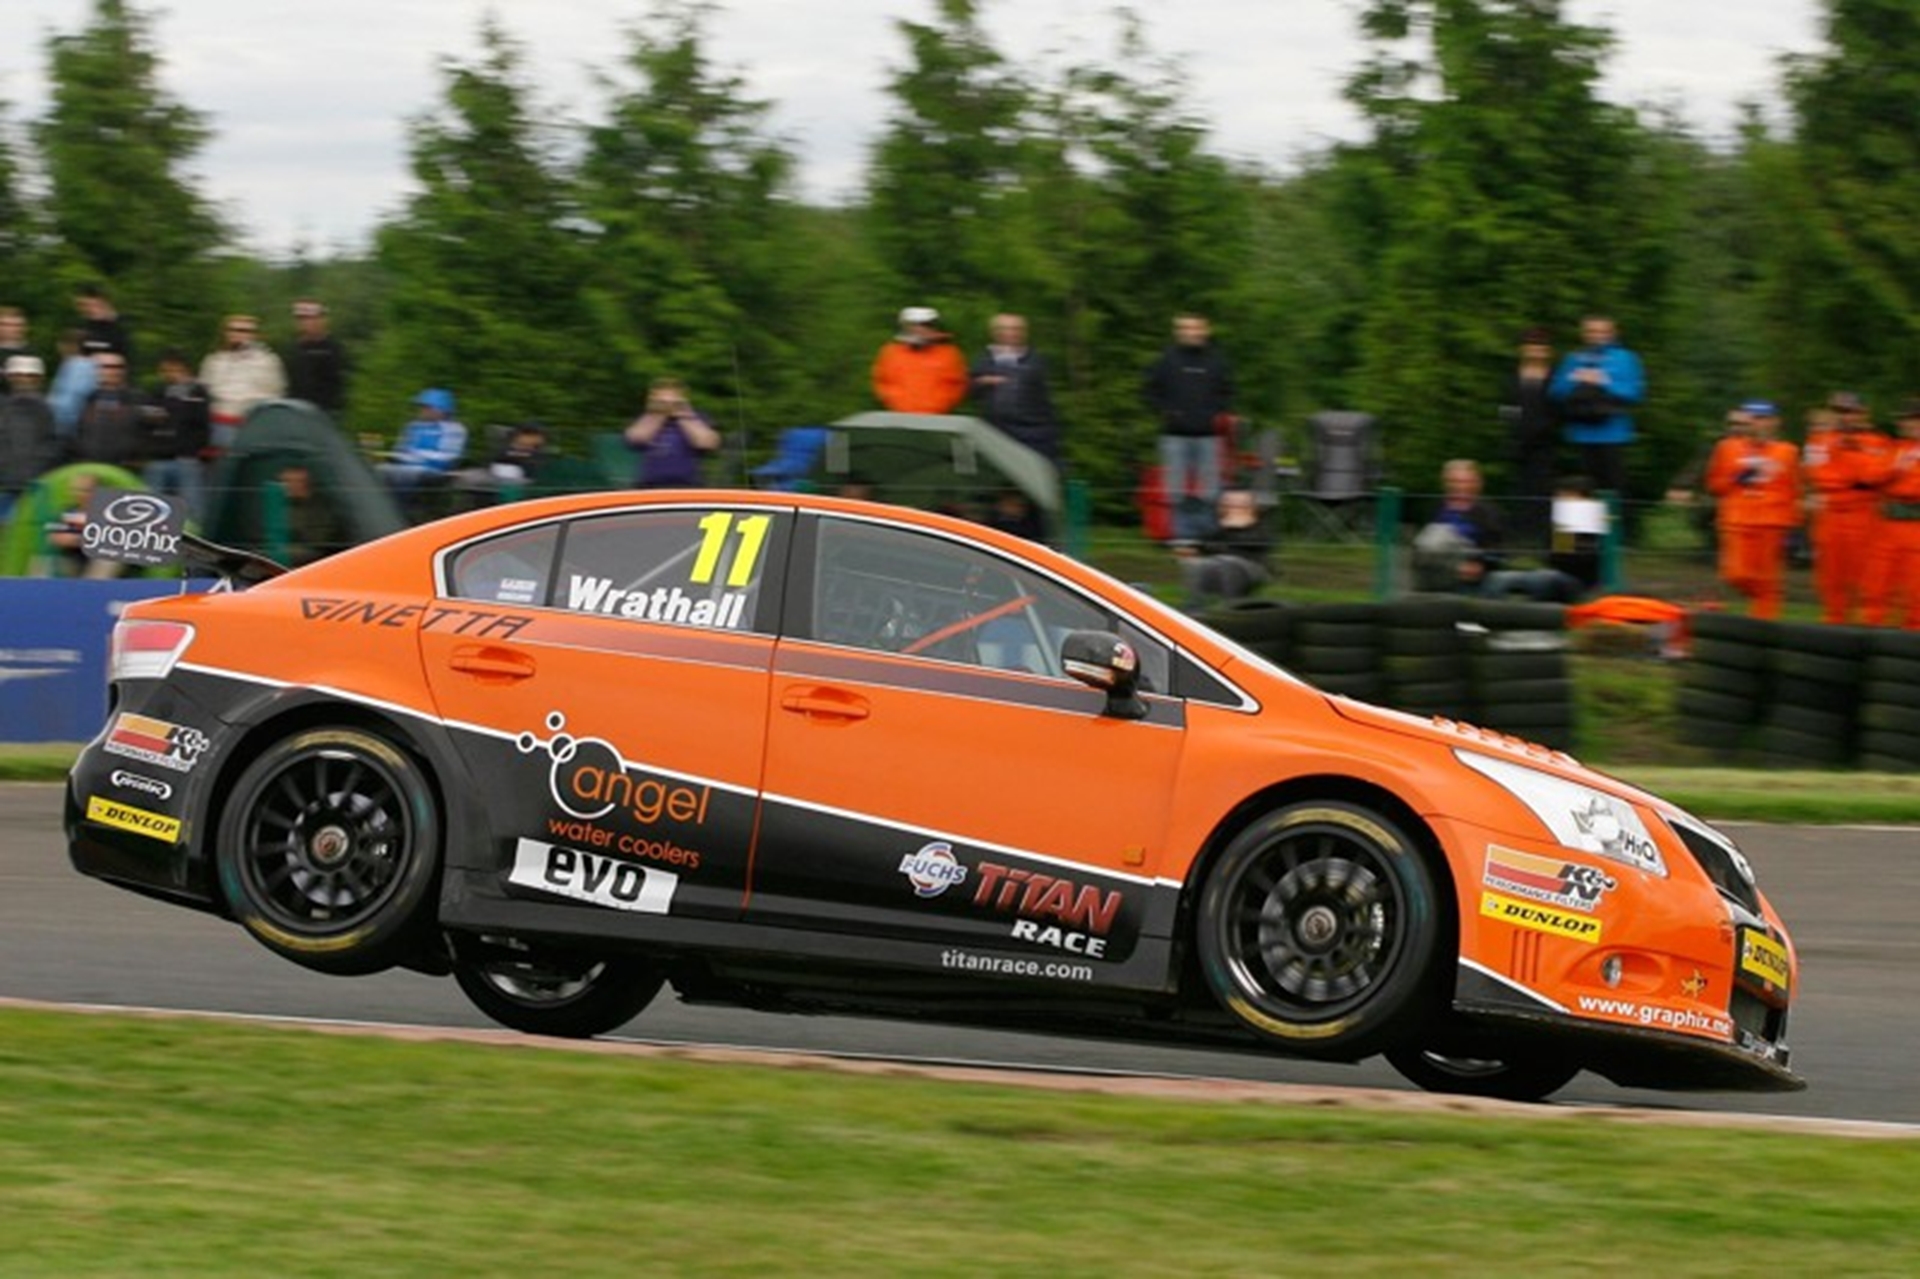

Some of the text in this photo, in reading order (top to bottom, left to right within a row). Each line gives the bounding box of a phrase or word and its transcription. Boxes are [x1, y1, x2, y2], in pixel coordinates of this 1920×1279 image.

[83, 522, 180, 554] graphix
[689, 512, 771, 587] 11
[300, 598, 534, 640] GINETTA
[567, 574, 745, 628] Wrathall
[572, 765, 712, 824] angel
[105, 807, 176, 833] DUNLOP
[549, 818, 700, 869] water coolers
[544, 845, 648, 902] evo
[901, 857, 967, 883] FUCHS
[1558, 864, 1616, 901] K&N
[1504, 904, 1596, 933] DUNLOP
[1011, 919, 1107, 958] RACE
[941, 950, 1092, 981] titanrace.com
